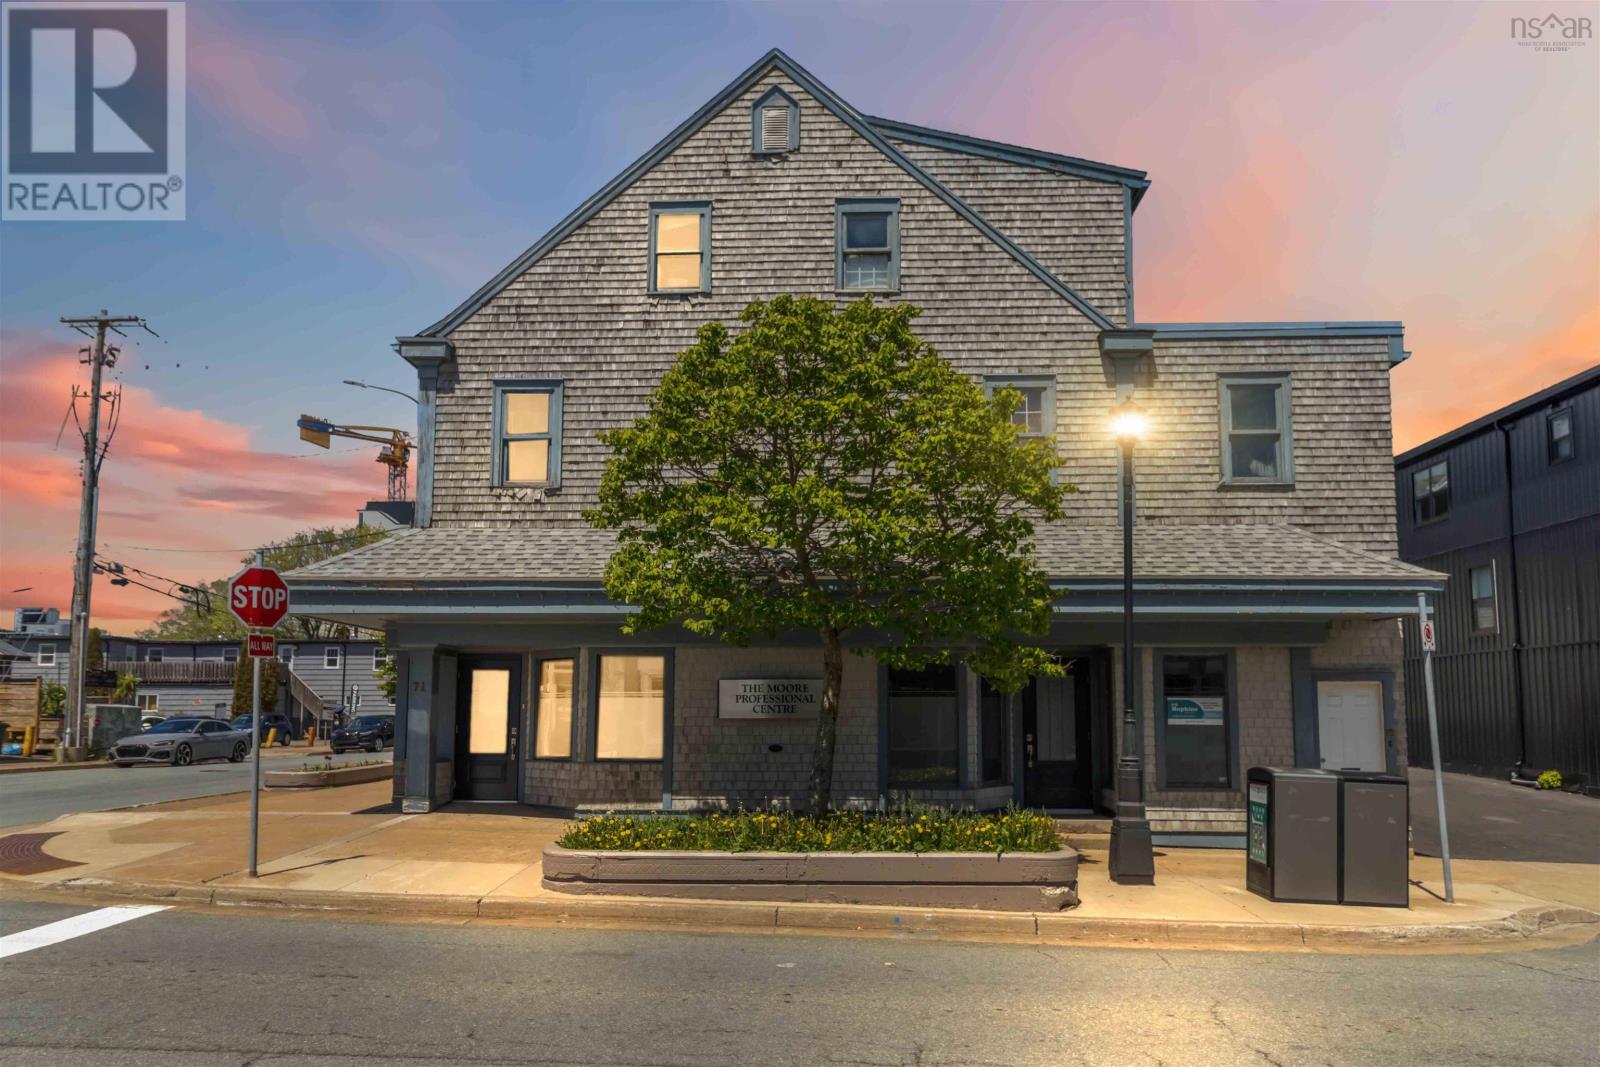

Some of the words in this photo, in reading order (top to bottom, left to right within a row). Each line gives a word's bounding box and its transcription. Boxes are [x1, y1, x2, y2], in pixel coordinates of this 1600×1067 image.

[233, 585, 286, 610] STOP
[250, 641, 260, 651] ALL
[261, 641, 273, 651] WAY
[741, 683, 764, 693] THE
[767, 683, 810, 693] MOORE
[735, 694, 817, 704] PROFESSIONAL
[752, 704, 800, 714] CENTRE
